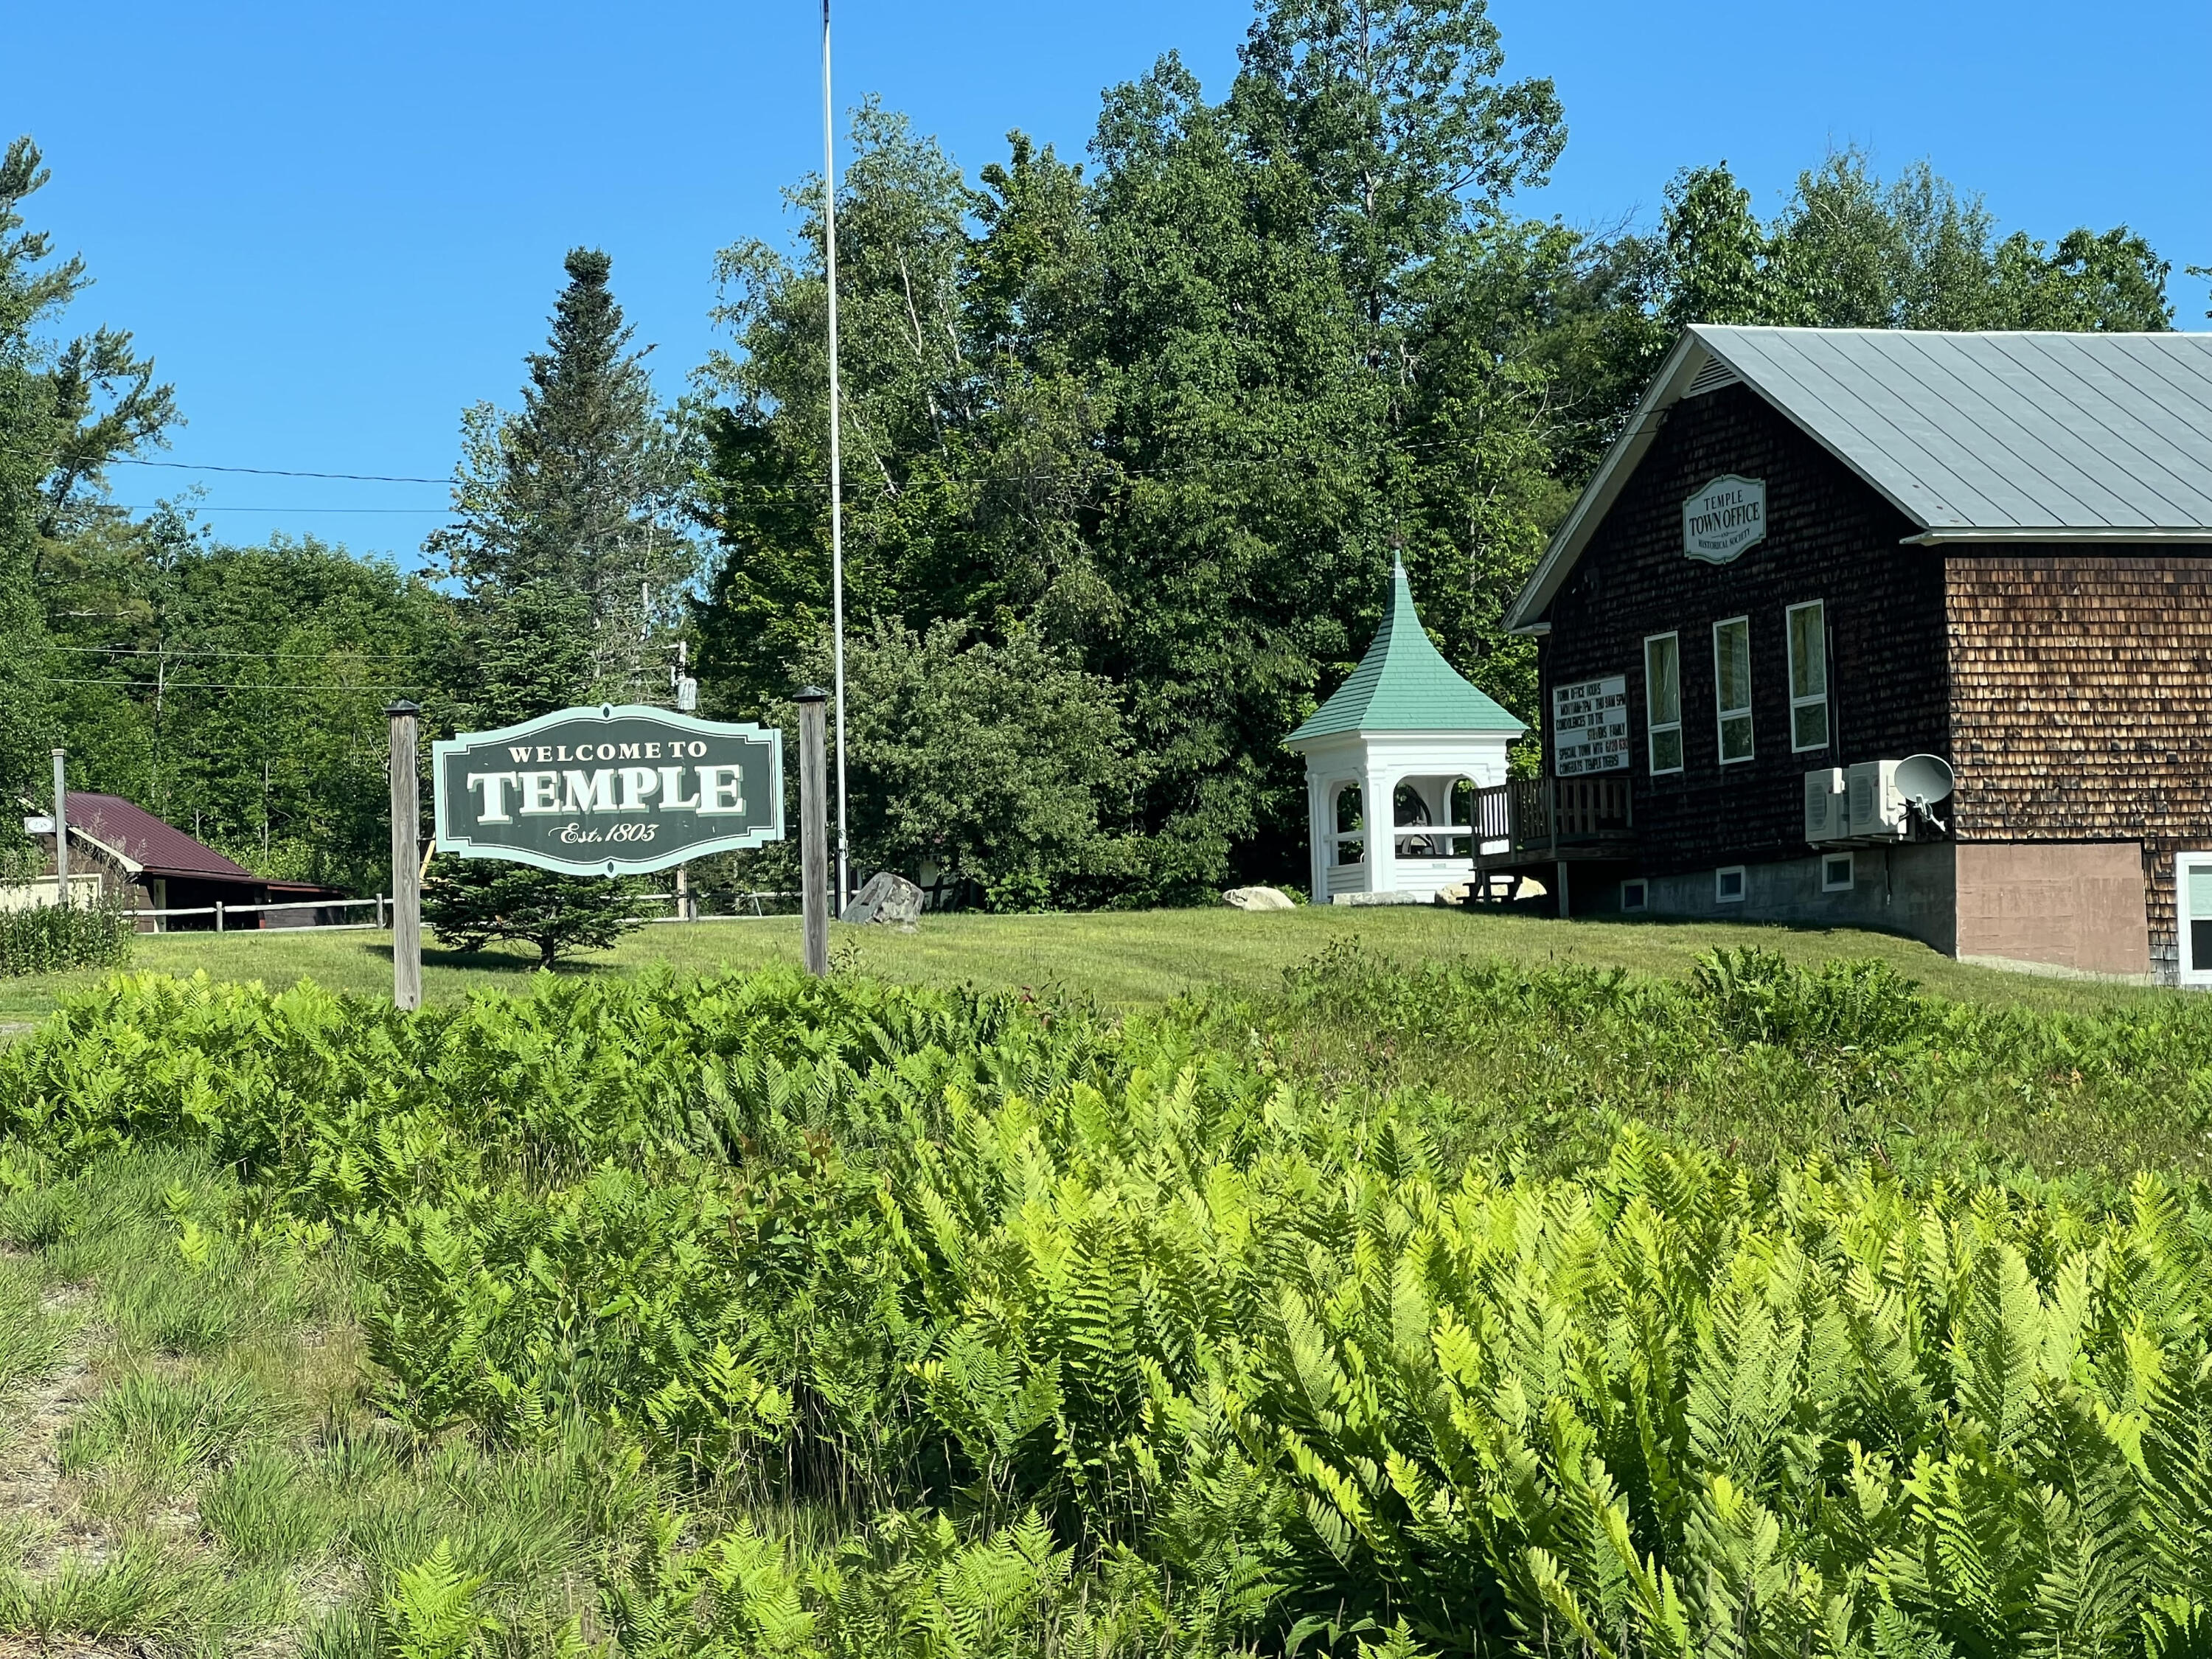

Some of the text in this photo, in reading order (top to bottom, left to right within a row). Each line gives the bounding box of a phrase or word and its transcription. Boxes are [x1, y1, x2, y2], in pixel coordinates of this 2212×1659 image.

[1704, 490, 1743, 511] TEMPLE
[1688, 501, 1760, 536] TOWN OFFICE
[1699, 529, 1750, 550] HISTORICAL SOCIETY
[1557, 689, 1569, 702] TOWN
[1588, 714, 1594, 726] TO
[1596, 712, 1604, 724] THE
[507, 740, 708, 763] WELCOME TO
[1579, 743, 1591, 757] TOWN
[1585, 757, 1601, 771] TEMPLE
[466, 764, 745, 826] TEMPLE
[548, 822, 661, 844] Est. 1803
